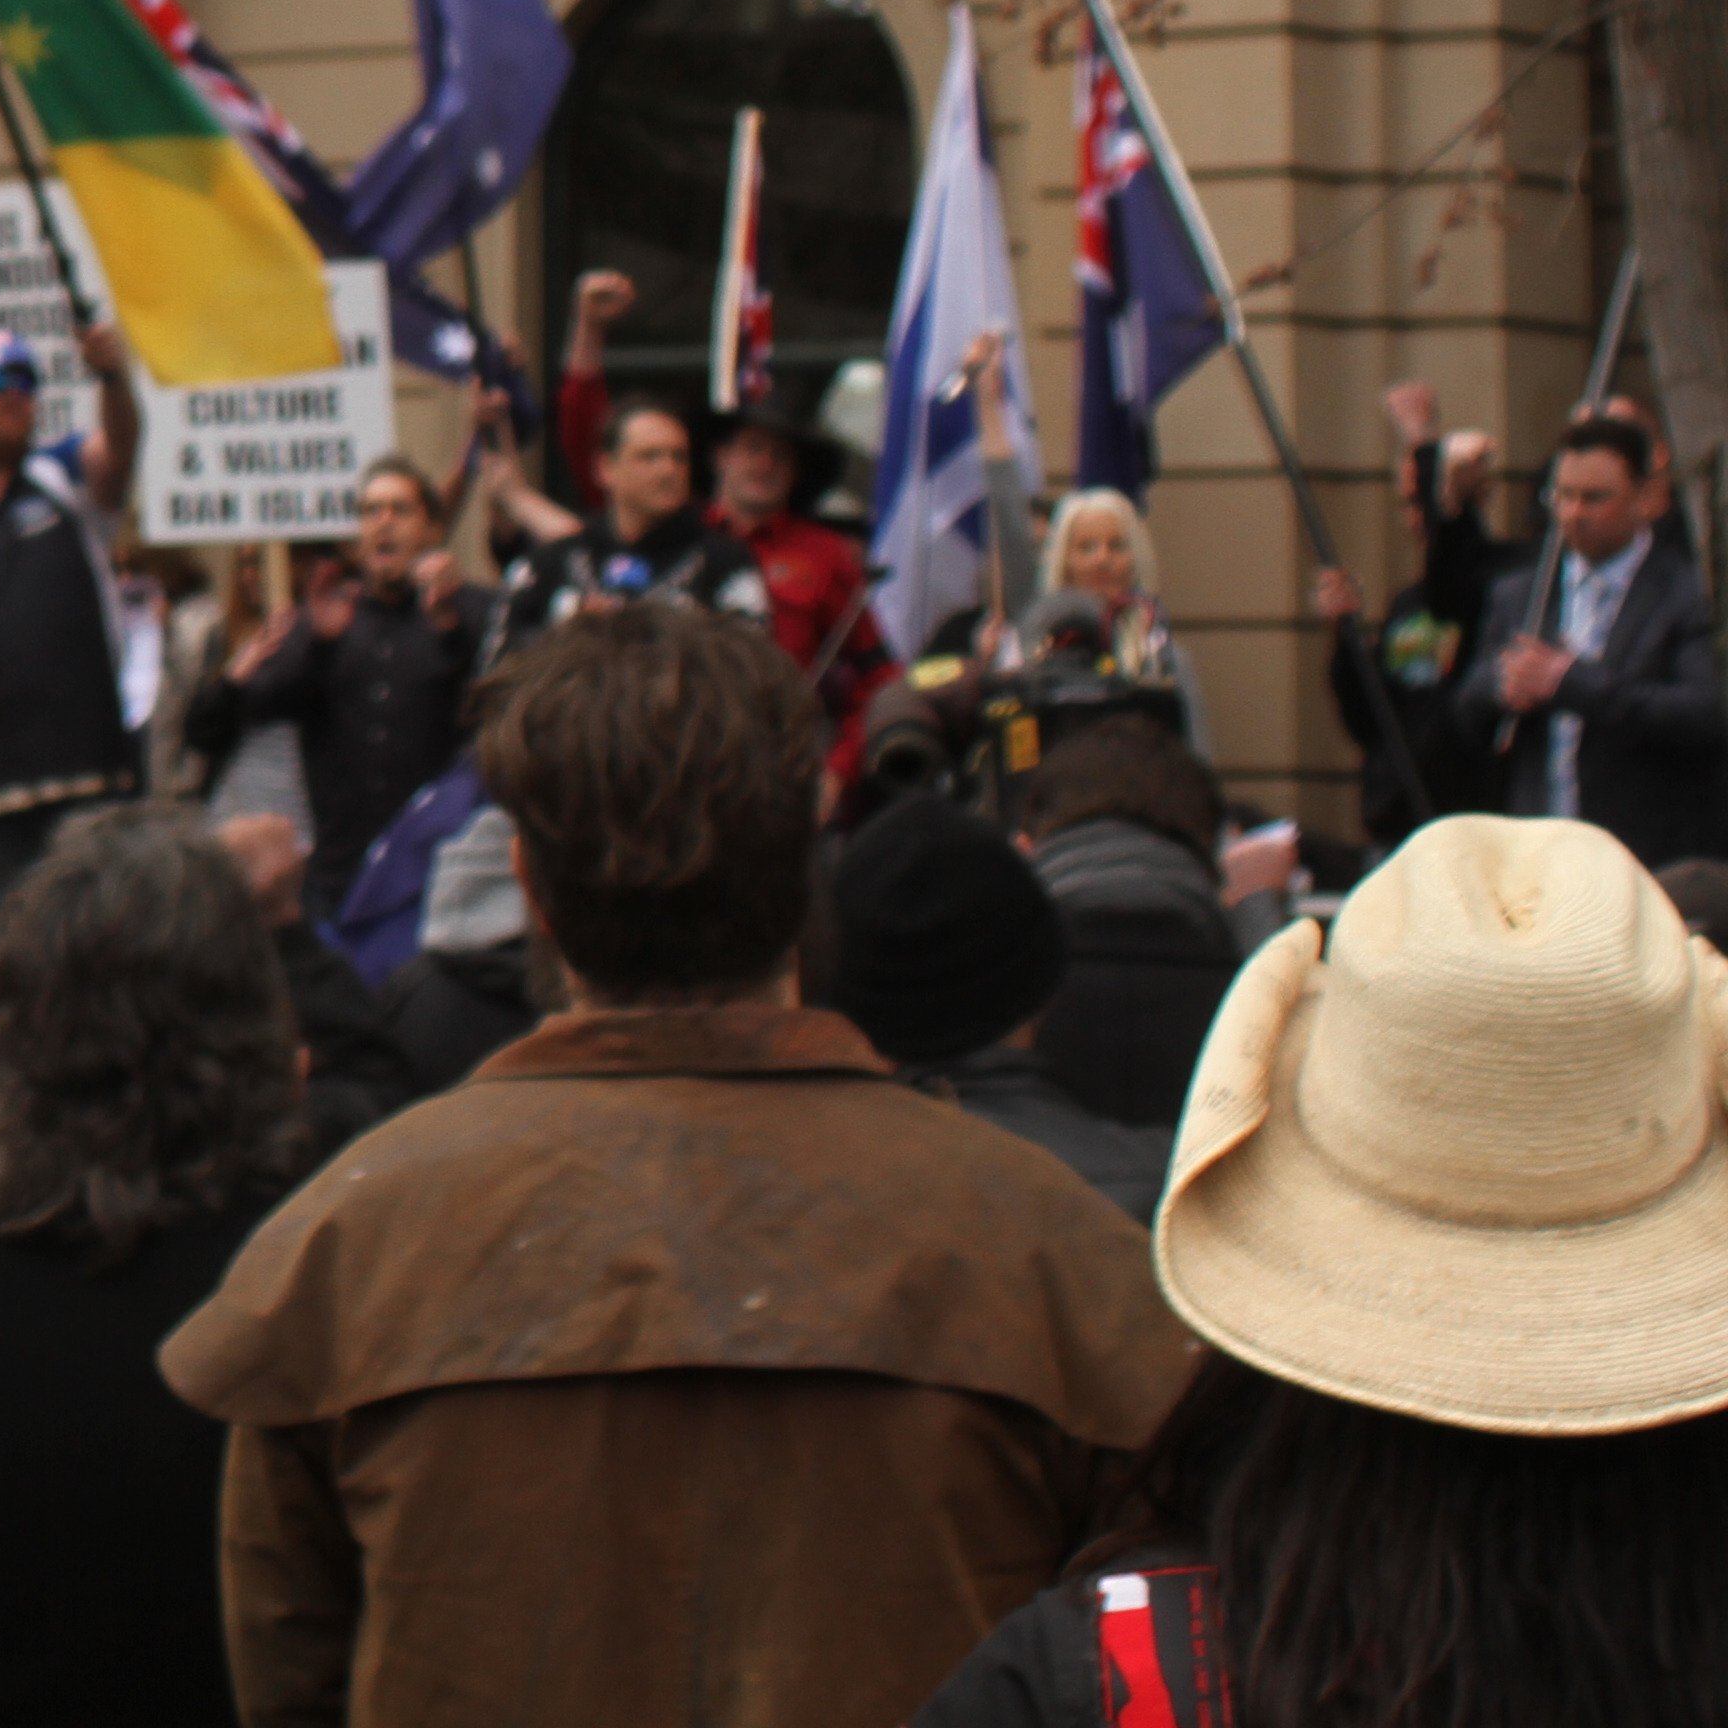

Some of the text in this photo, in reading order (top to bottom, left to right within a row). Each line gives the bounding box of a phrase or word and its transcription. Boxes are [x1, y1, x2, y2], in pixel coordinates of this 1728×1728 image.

[188, 386, 339, 426] CULTURE
[181, 435, 357, 478] & VALUES
[170, 493, 239, 526] BAN
